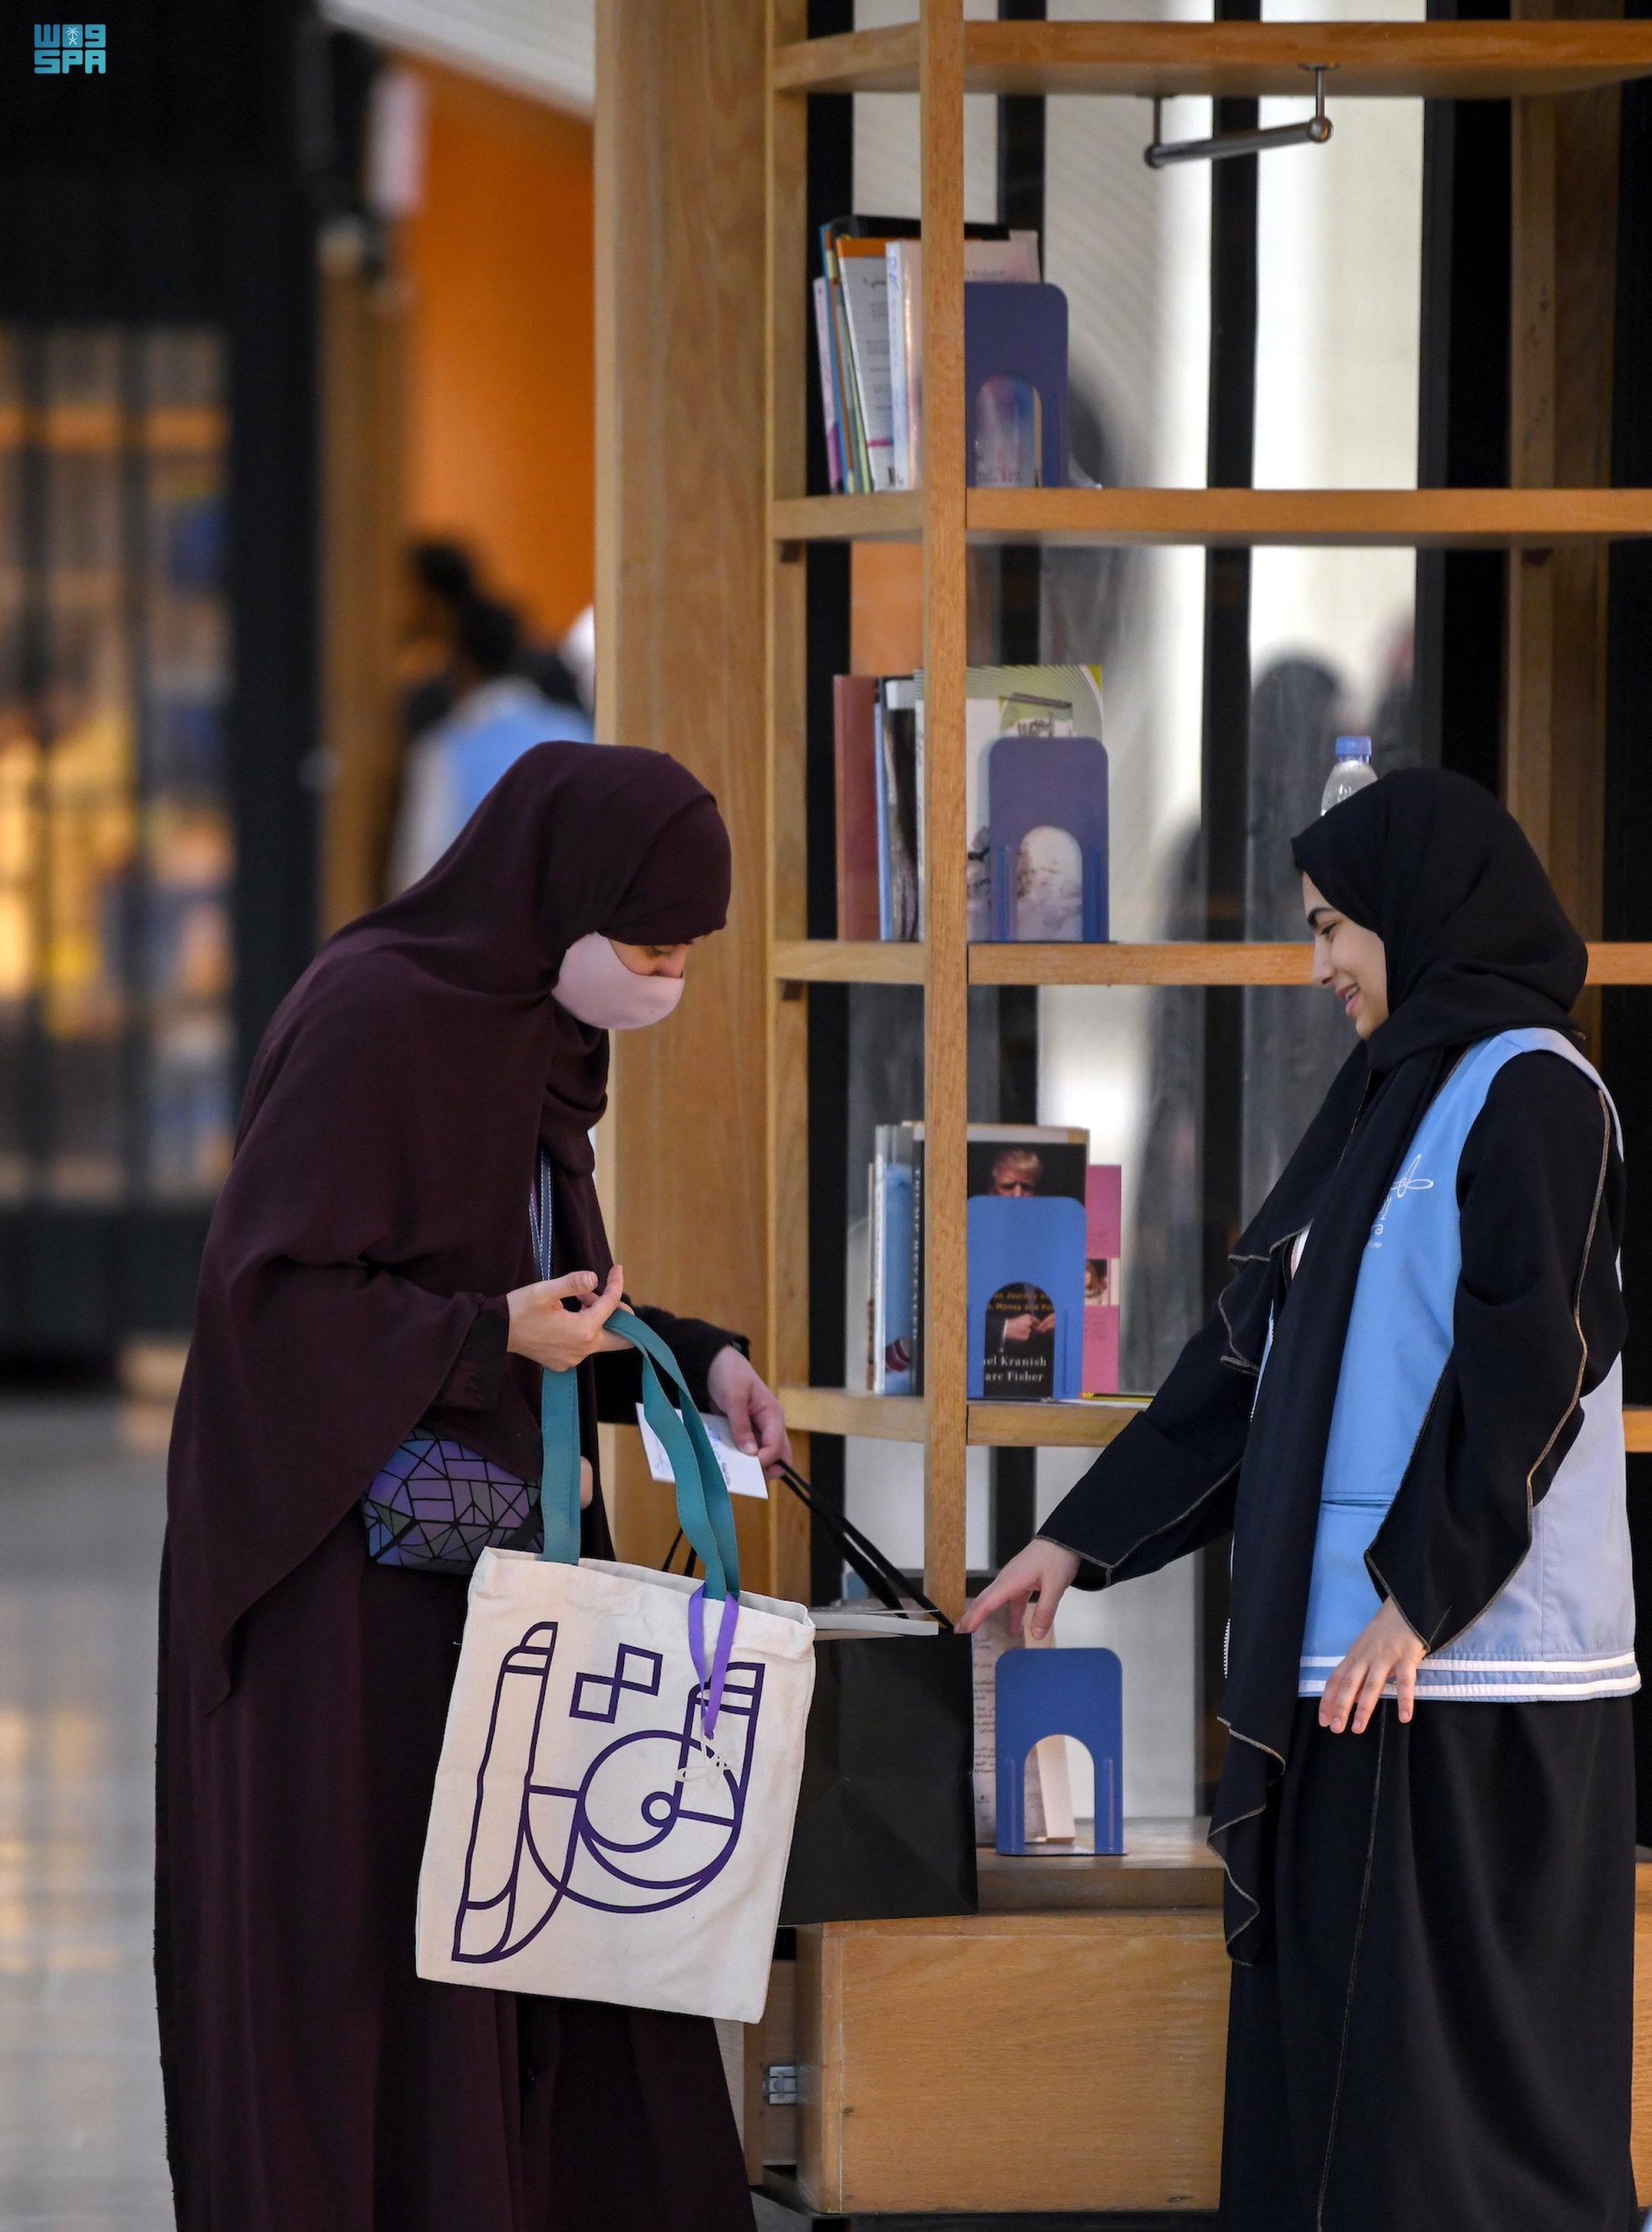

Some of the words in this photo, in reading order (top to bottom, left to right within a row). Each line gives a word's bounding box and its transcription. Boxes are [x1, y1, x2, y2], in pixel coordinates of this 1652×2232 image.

[995, 1303, 1021, 1311] Money
[1001, 1355, 1047, 1365] Kranish
[1008, 1371, 1044, 1382] Fisher
